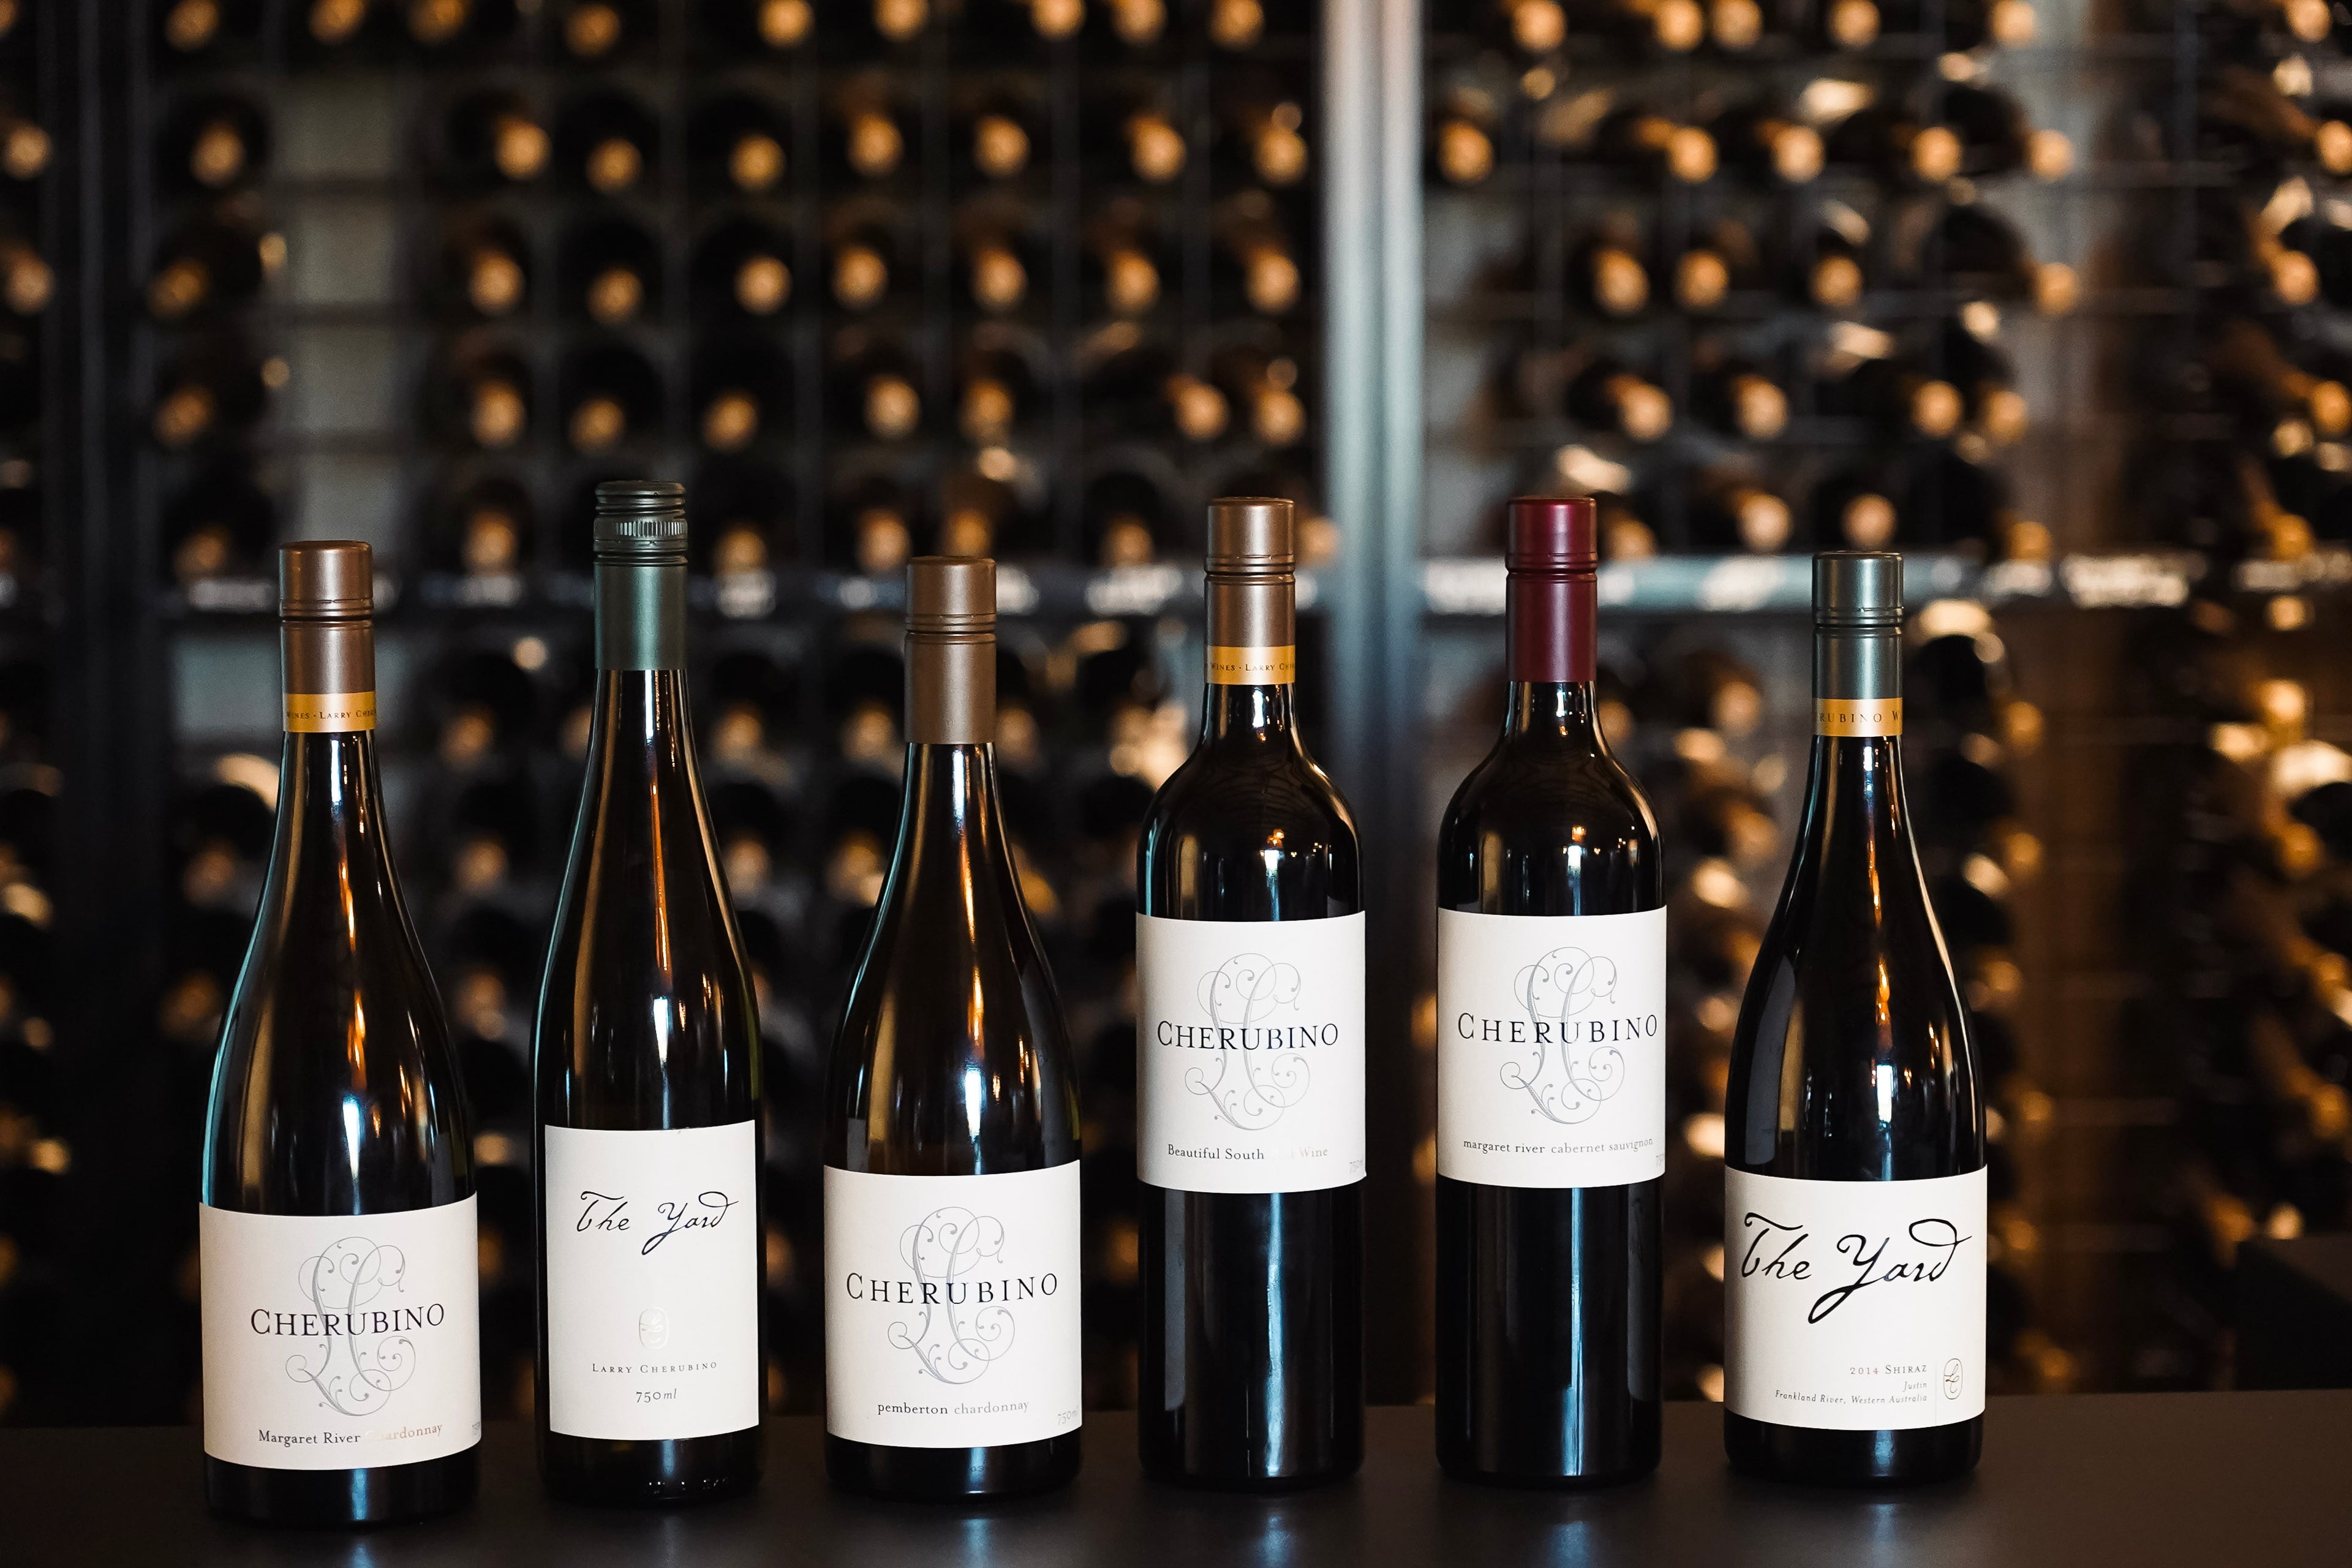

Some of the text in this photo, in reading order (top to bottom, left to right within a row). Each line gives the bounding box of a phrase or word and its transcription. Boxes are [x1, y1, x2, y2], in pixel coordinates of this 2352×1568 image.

[319, 711, 352, 720] LARRY
[1157, 1020, 1338, 1050] CHERUBINO
[1458, 1012, 1657, 1044] CHERUBINO
[1167, 1144, 1220, 1159] Beautiful
[1225, 1148, 1265, 1160] South
[1298, 1147, 1329, 1158] Wine
[1463, 1137, 1654, 1154] margaret river cabernet sauvignon
[577, 1190, 739, 1256] The Yard
[1741, 1212, 1973, 1324] The Yard
[846, 1272, 1058, 1305] CHERUBINO
[250, 1303, 445, 1336] CHERUBINO
[592, 1362, 717, 1373] LARRY CHERUBINO
[1849, 1364, 1928, 1376] 2014 SHIRAZ
[1902, 1381, 1928, 1392] Justin
[636, 1388, 677, 1403] 750ml
[1774, 1389, 1928, 1404] Frankland River, Western Australia
[877, 1401, 1030, 1415] pemberton chardonnay
[258, 1424, 443, 1448] Margaret River Cardonnay
